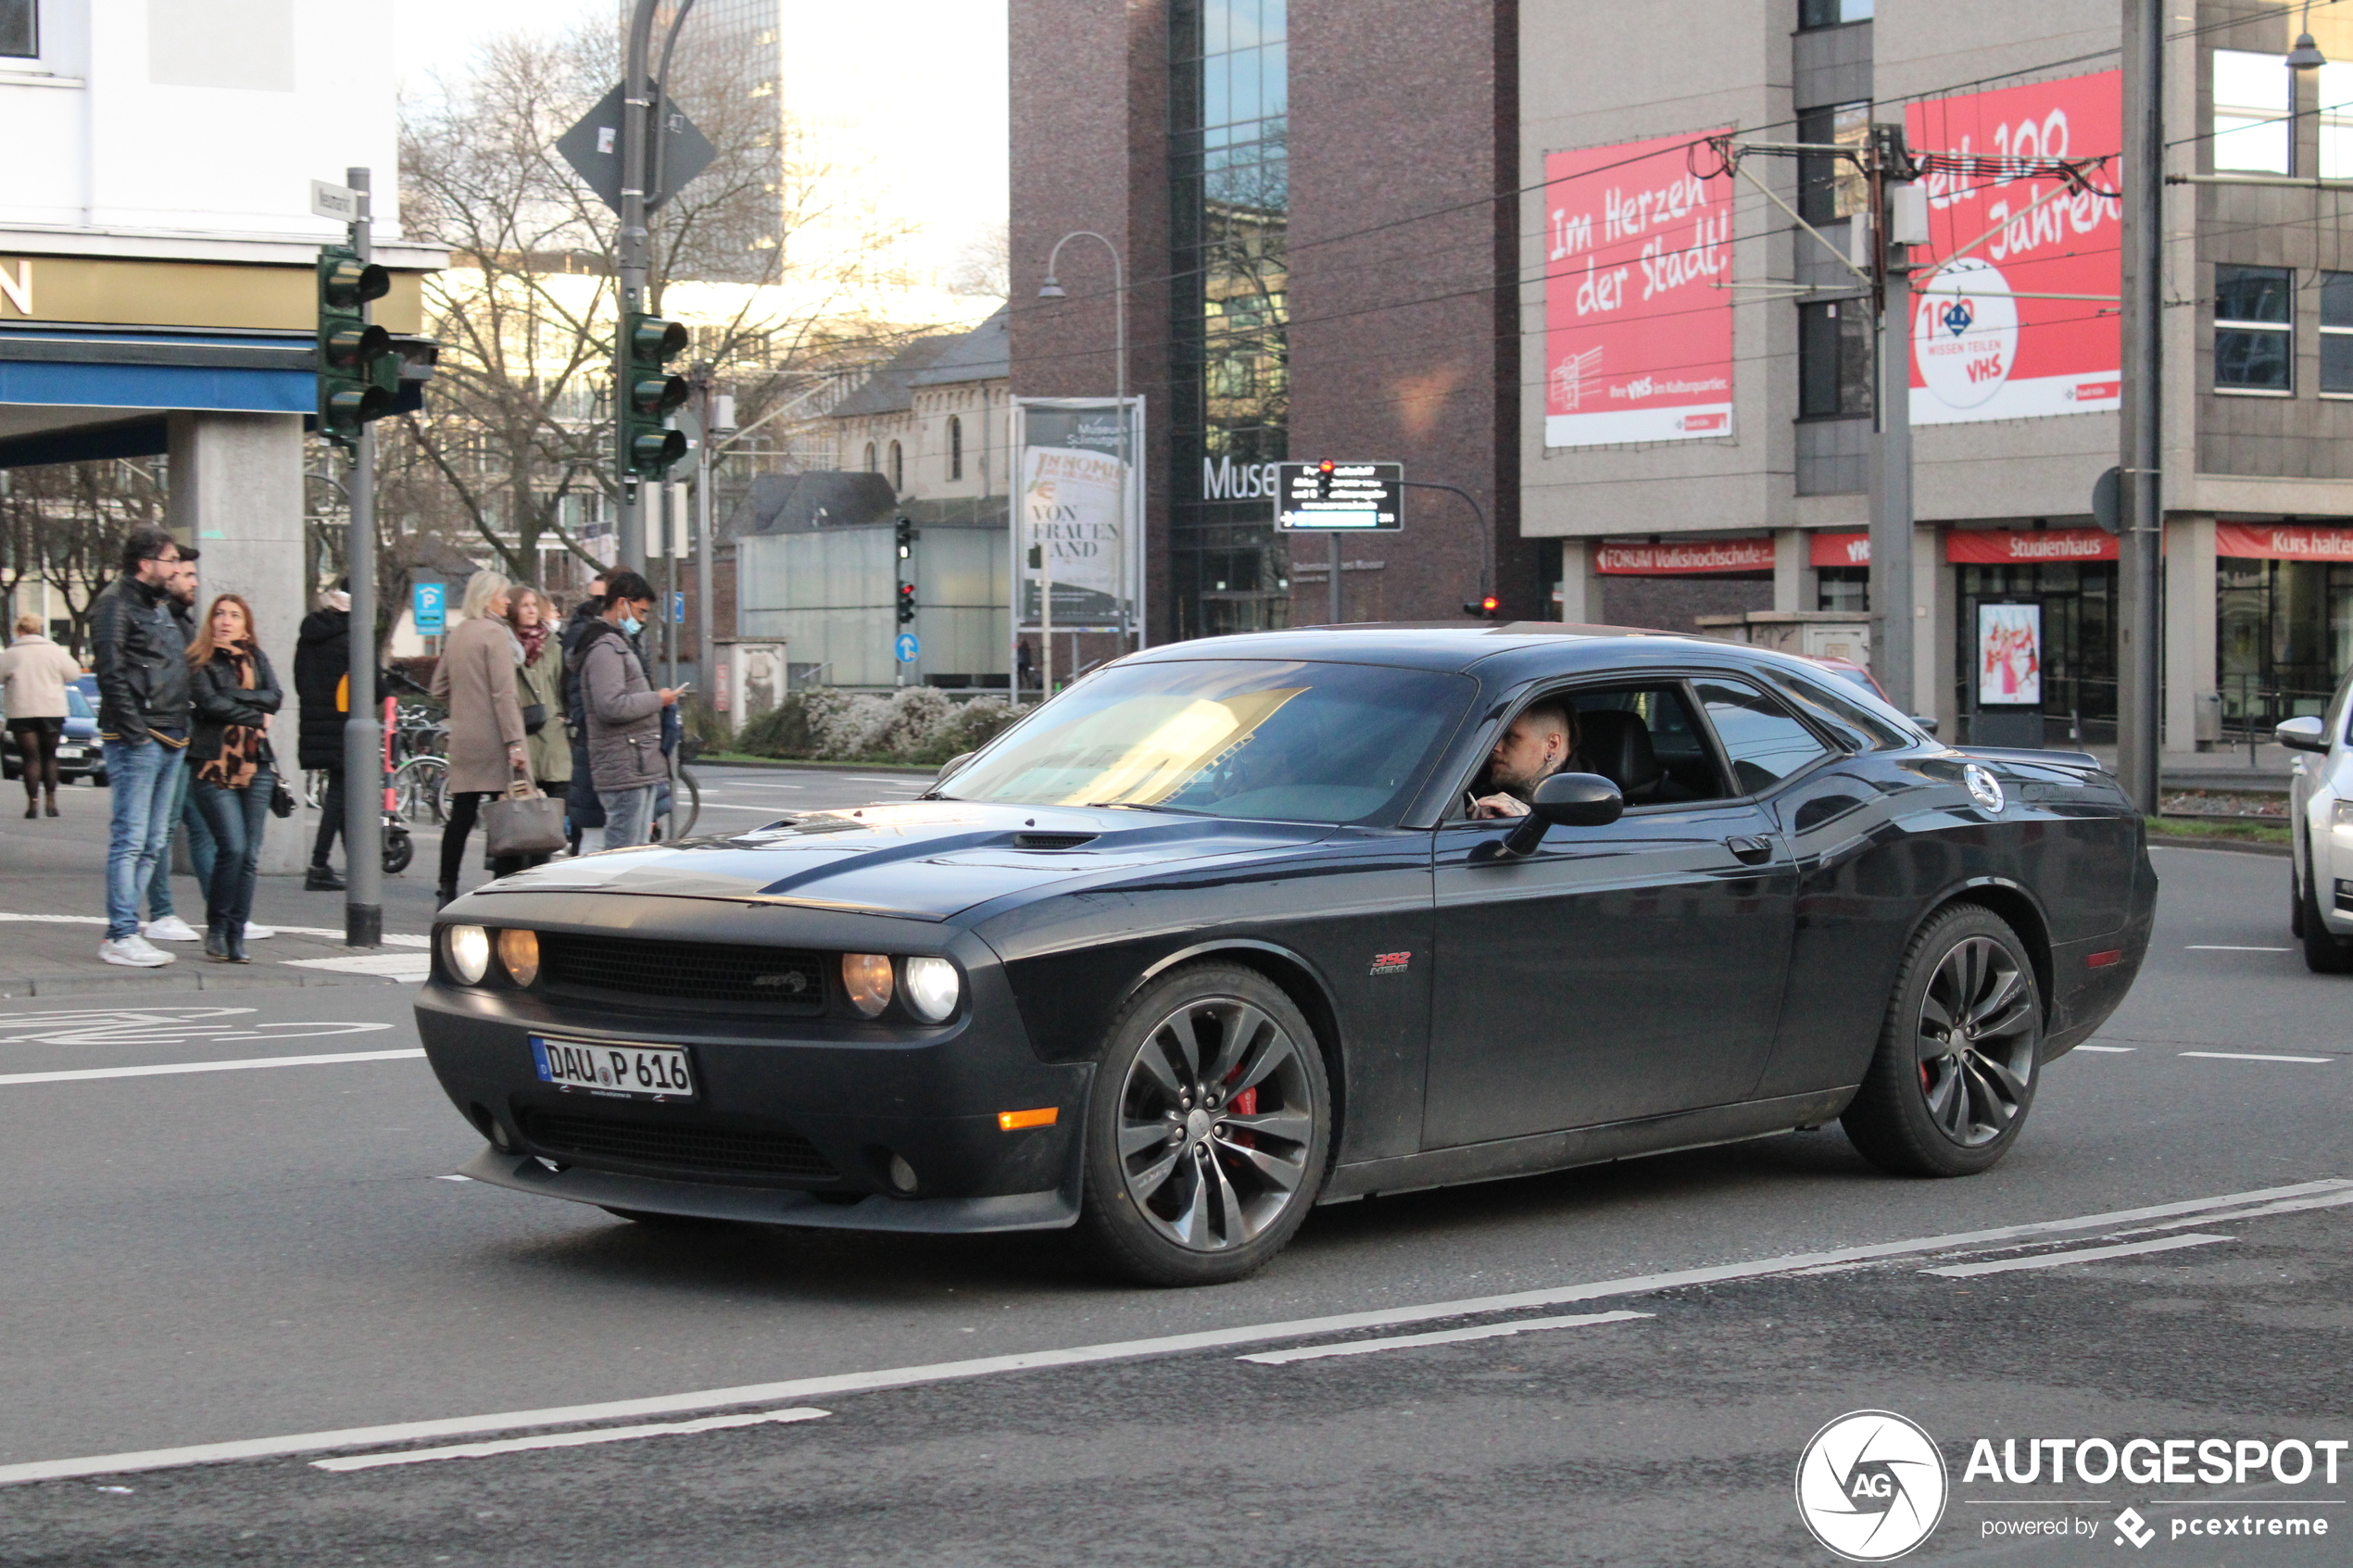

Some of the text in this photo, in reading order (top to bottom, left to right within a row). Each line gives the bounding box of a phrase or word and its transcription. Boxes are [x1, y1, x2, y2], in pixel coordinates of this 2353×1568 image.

[1994, 107, 2070, 188] 100
[1551, 172, 1707, 261] Im Herzen
[1577, 209, 1728, 316] der Stadt!
[1928, 340, 2002, 356] WISSEN TEILEN
[1967, 353, 2003, 383] VHS
[1609, 385, 1627, 398] Ihre
[1627, 376, 1653, 400] VHS
[1032, 505, 1077, 521] VON
[1033, 523, 1119, 539] FRAUEN
[2272, 531, 2309, 554] Kurs
[1606, 549, 1653, 568] FORUM
[1654, 543, 1760, 568] Volkshochschule
[2009, 534, 2102, 557] Studienhaus
[422, 594, 437, 608] P
[1373, 951, 1412, 967] 392
[545, 1044, 688, 1090] DAU P 616
